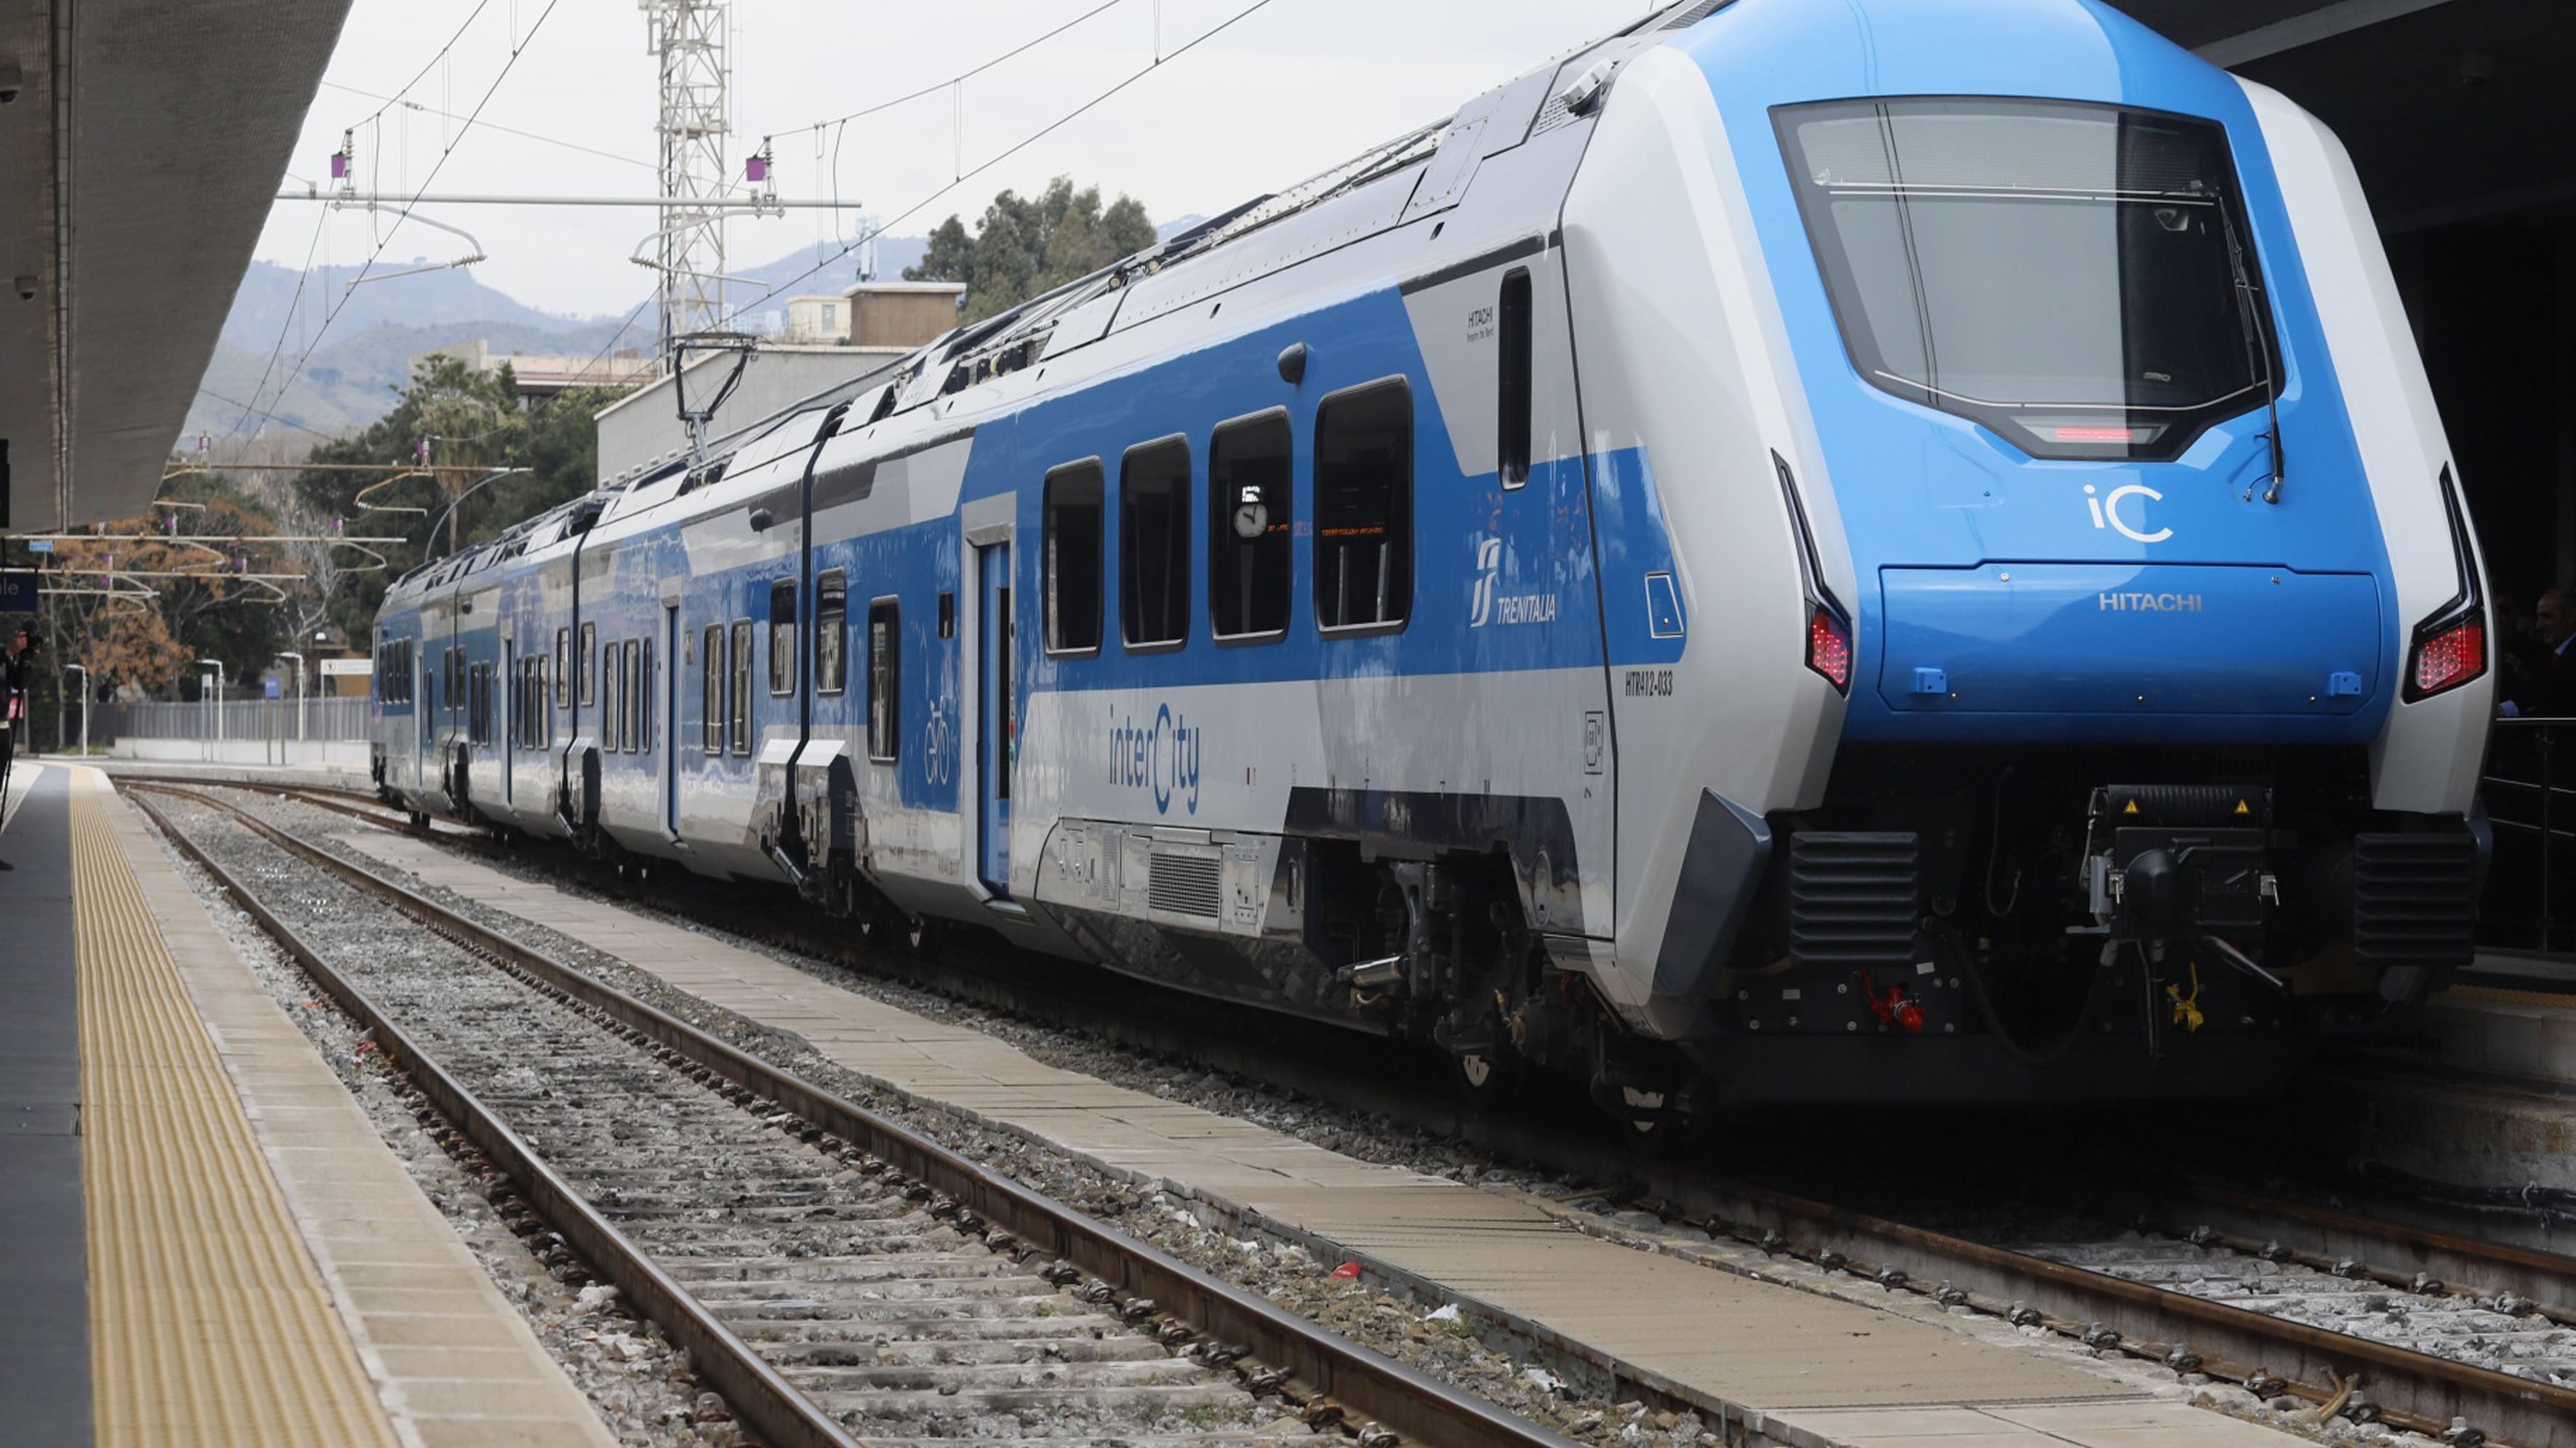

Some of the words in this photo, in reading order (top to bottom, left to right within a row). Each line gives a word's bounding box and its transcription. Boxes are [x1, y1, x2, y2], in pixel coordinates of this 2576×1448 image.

[1468, 306, 1493, 328] HITACHI
[2083, 484, 2173, 543] iC
[0, 576, 19, 595] le
[1498, 594, 1555, 624] TRENITALIA
[2099, 592, 2202, 611] HITACHI
[1625, 670, 1673, 697] HTR412-033
[1110, 702, 1200, 816] interCity
